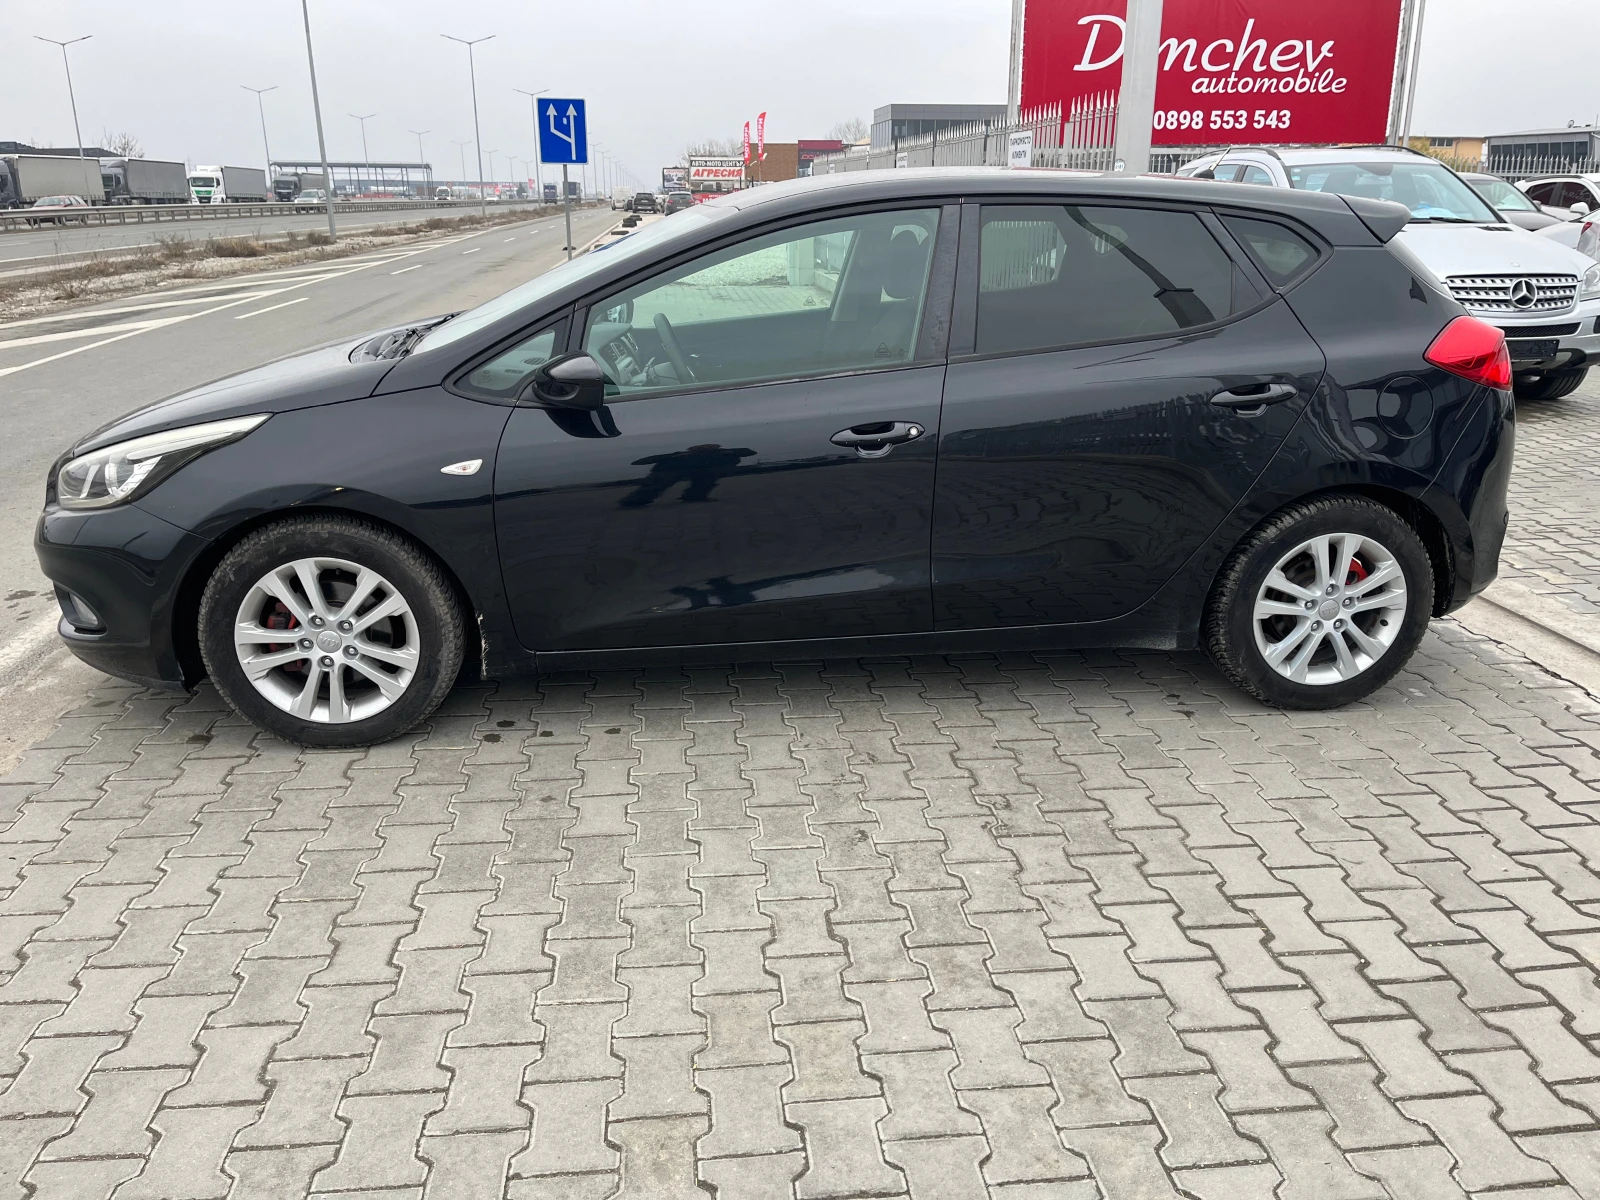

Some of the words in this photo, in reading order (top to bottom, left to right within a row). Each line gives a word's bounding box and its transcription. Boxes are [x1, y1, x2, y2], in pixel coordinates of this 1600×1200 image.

[1073, 14, 1335, 73] Dmchev
[1191, 67, 1348, 94] automobile
[1153, 110, 1204, 130] 0898
[1209, 110, 1248, 130] 553
[1252, 109, 1292, 129] 543
[693, 168, 742, 177] АГРЕСИЯ
[722, 160, 744, 168] ЦЕНТЪР
